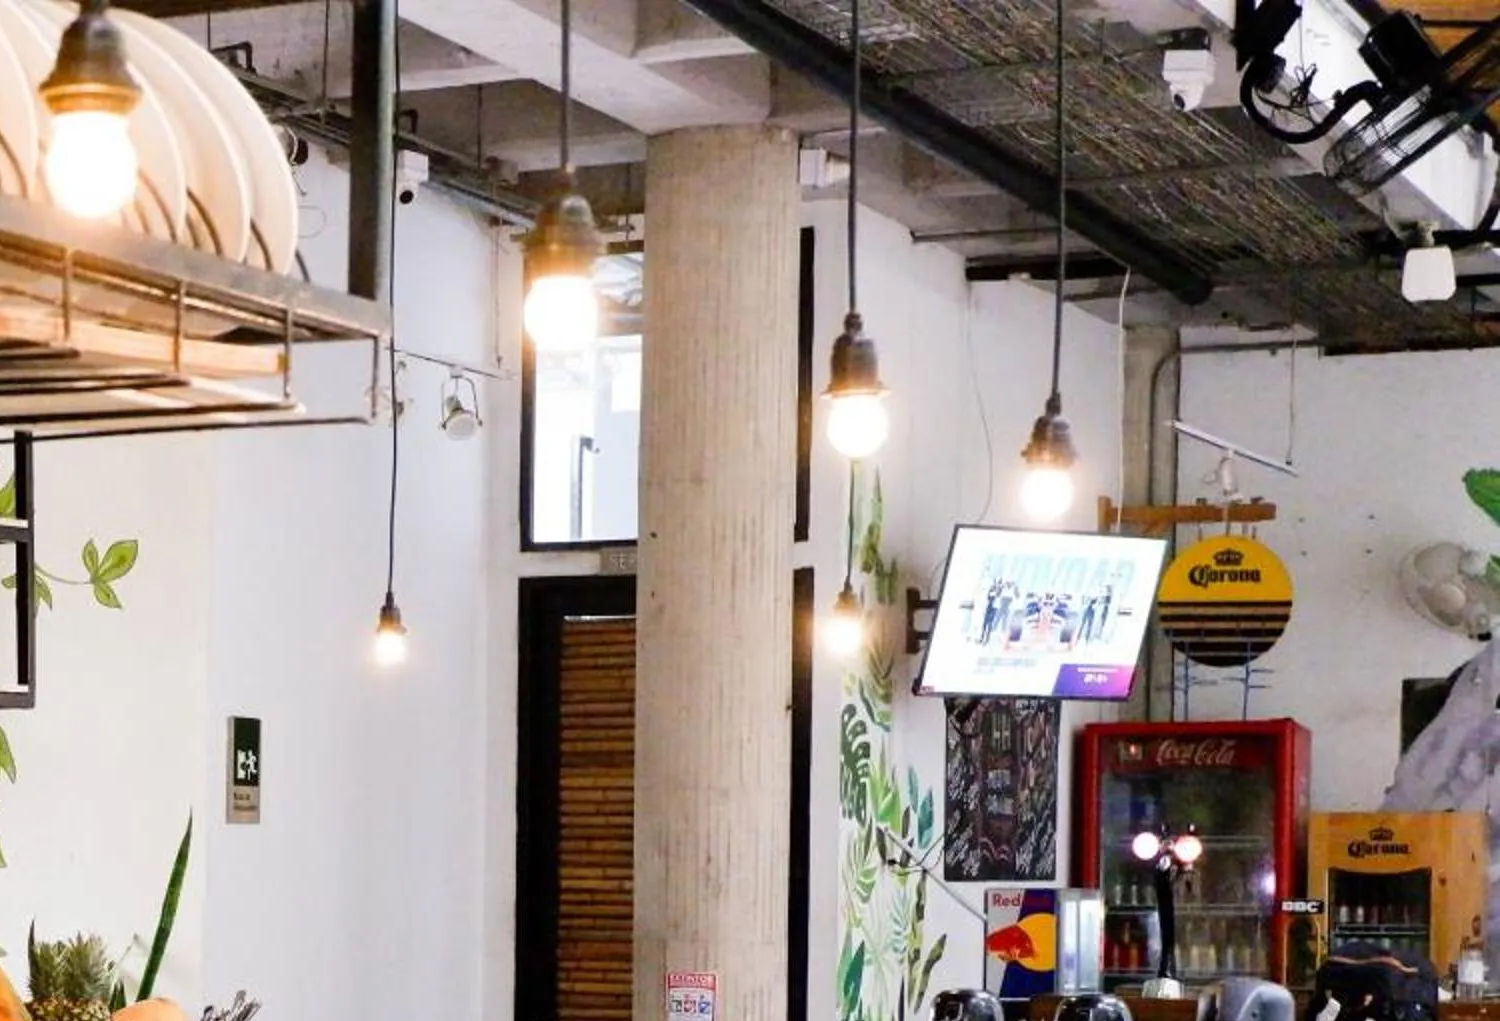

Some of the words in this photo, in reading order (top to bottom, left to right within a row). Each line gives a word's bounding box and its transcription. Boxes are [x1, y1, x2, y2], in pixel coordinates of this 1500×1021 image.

[1188, 563, 1262, 588] Corona
[1347, 840, 1410, 858] Corona
[992, 892, 1021, 907] Red
